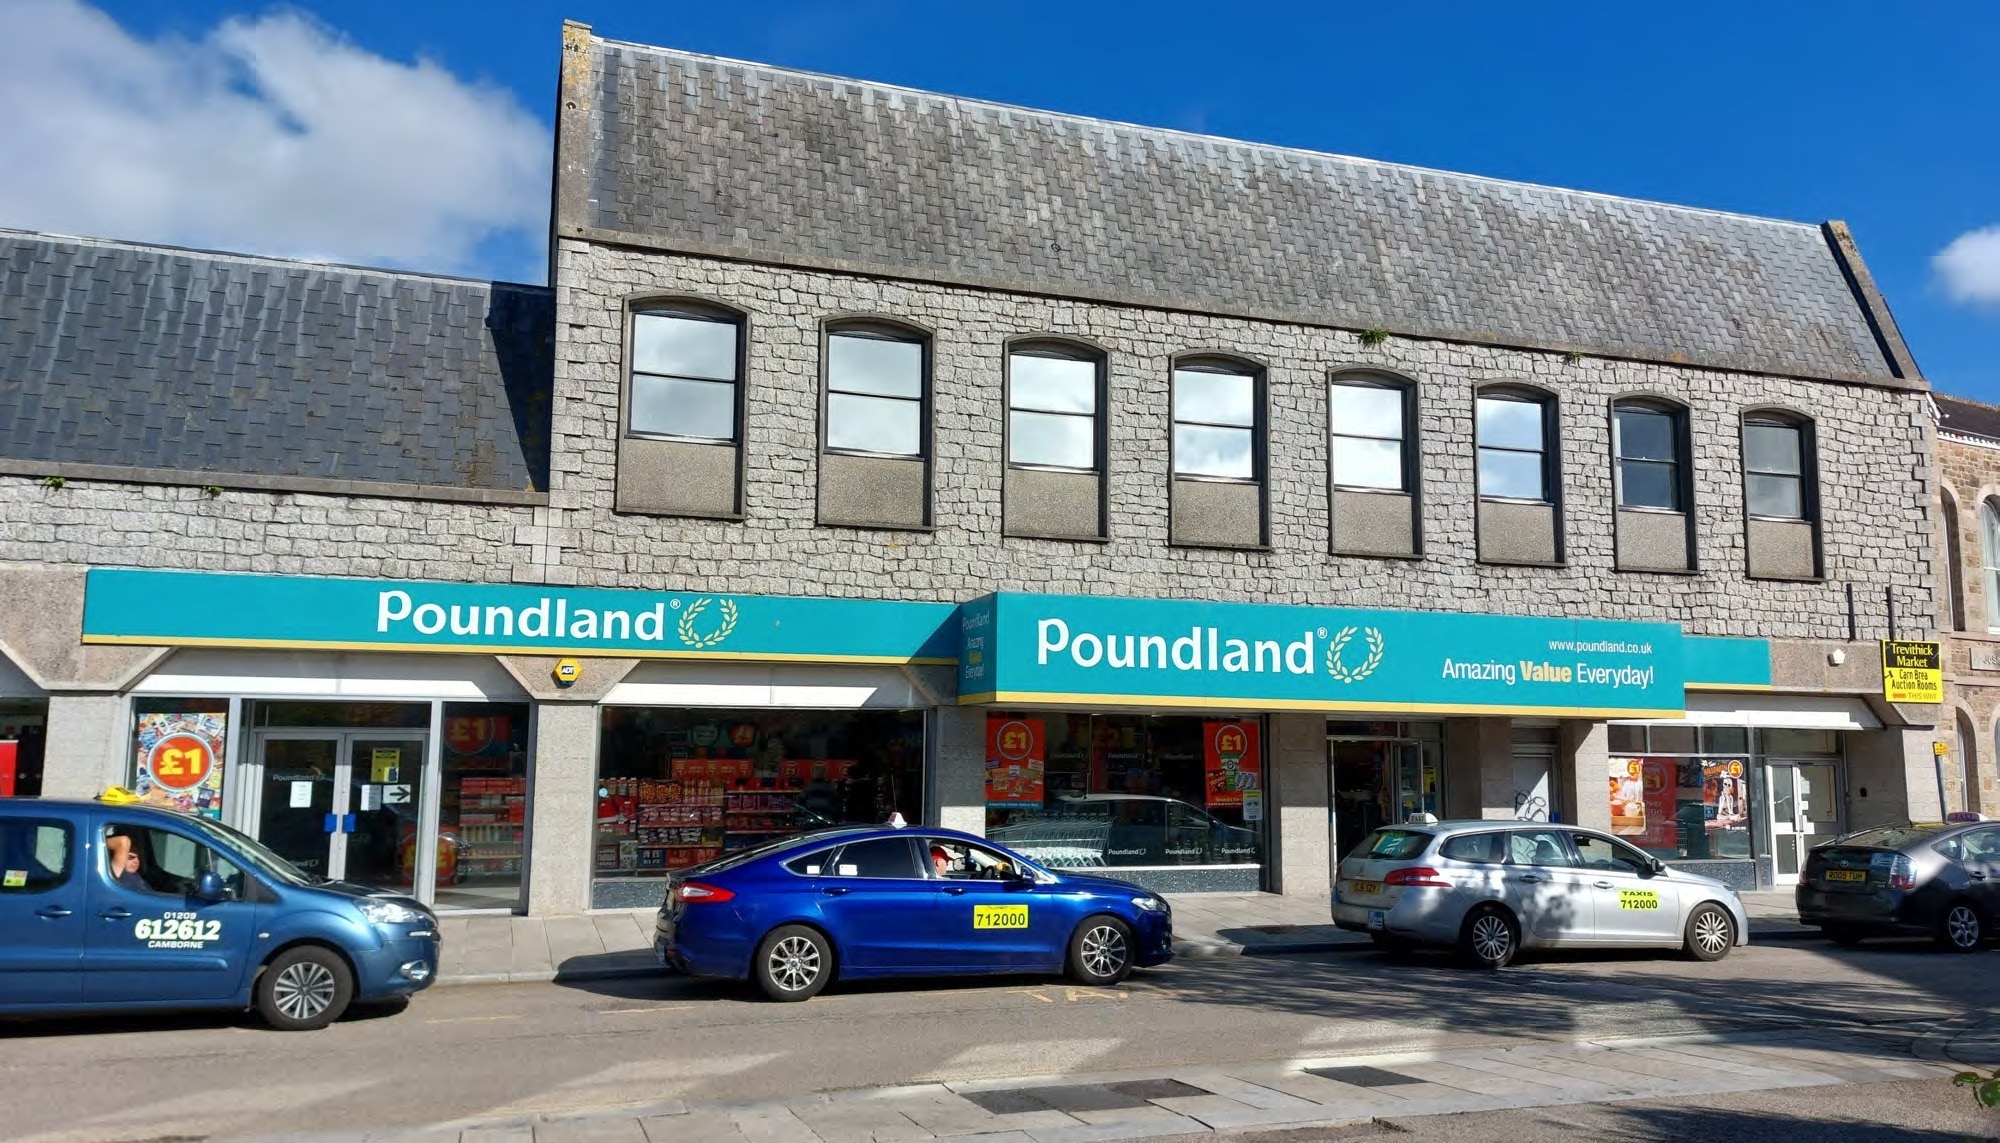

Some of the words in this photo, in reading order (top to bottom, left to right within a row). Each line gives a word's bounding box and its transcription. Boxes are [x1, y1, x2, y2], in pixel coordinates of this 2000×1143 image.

[1549, 640, 1652, 655] www.poundland.co.uk
[1890, 644, 1933, 656] Trevithick
[1896, 655, 1929, 668] Market
[562, 666, 575, 674] ADT
[1442, 657, 1516, 686] Amazing
[1519, 660, 1572, 683] Value
[1577, 662, 1655, 690] Everyday!
[1899, 669, 1914, 680] Carn
[1914, 669, 1929, 681] Brea
[1891, 680, 1916, 691] Auction
[1917, 680, 1938, 691] Rooms
[1907, 692, 1923, 700] THIS
[1924, 692, 1937, 700] WAY
[1003, 731, 1027, 749] £1
[1221, 734, 1242, 751] £1
[159, 748, 202, 775] £1
[1731, 764, 1741, 774] £1
[1109, 848, 1139, 856] Poundland
[1165, 848, 1196, 856] Poundland
[1221, 847, 1250, 855] Poundland
[1621, 900, 1658, 909] 712000
[163, 911, 197, 920] 01209
[976, 913, 1026, 927] 712000
[134, 918, 222, 941] 612612
[148, 940, 205, 949] CAMBORNE
